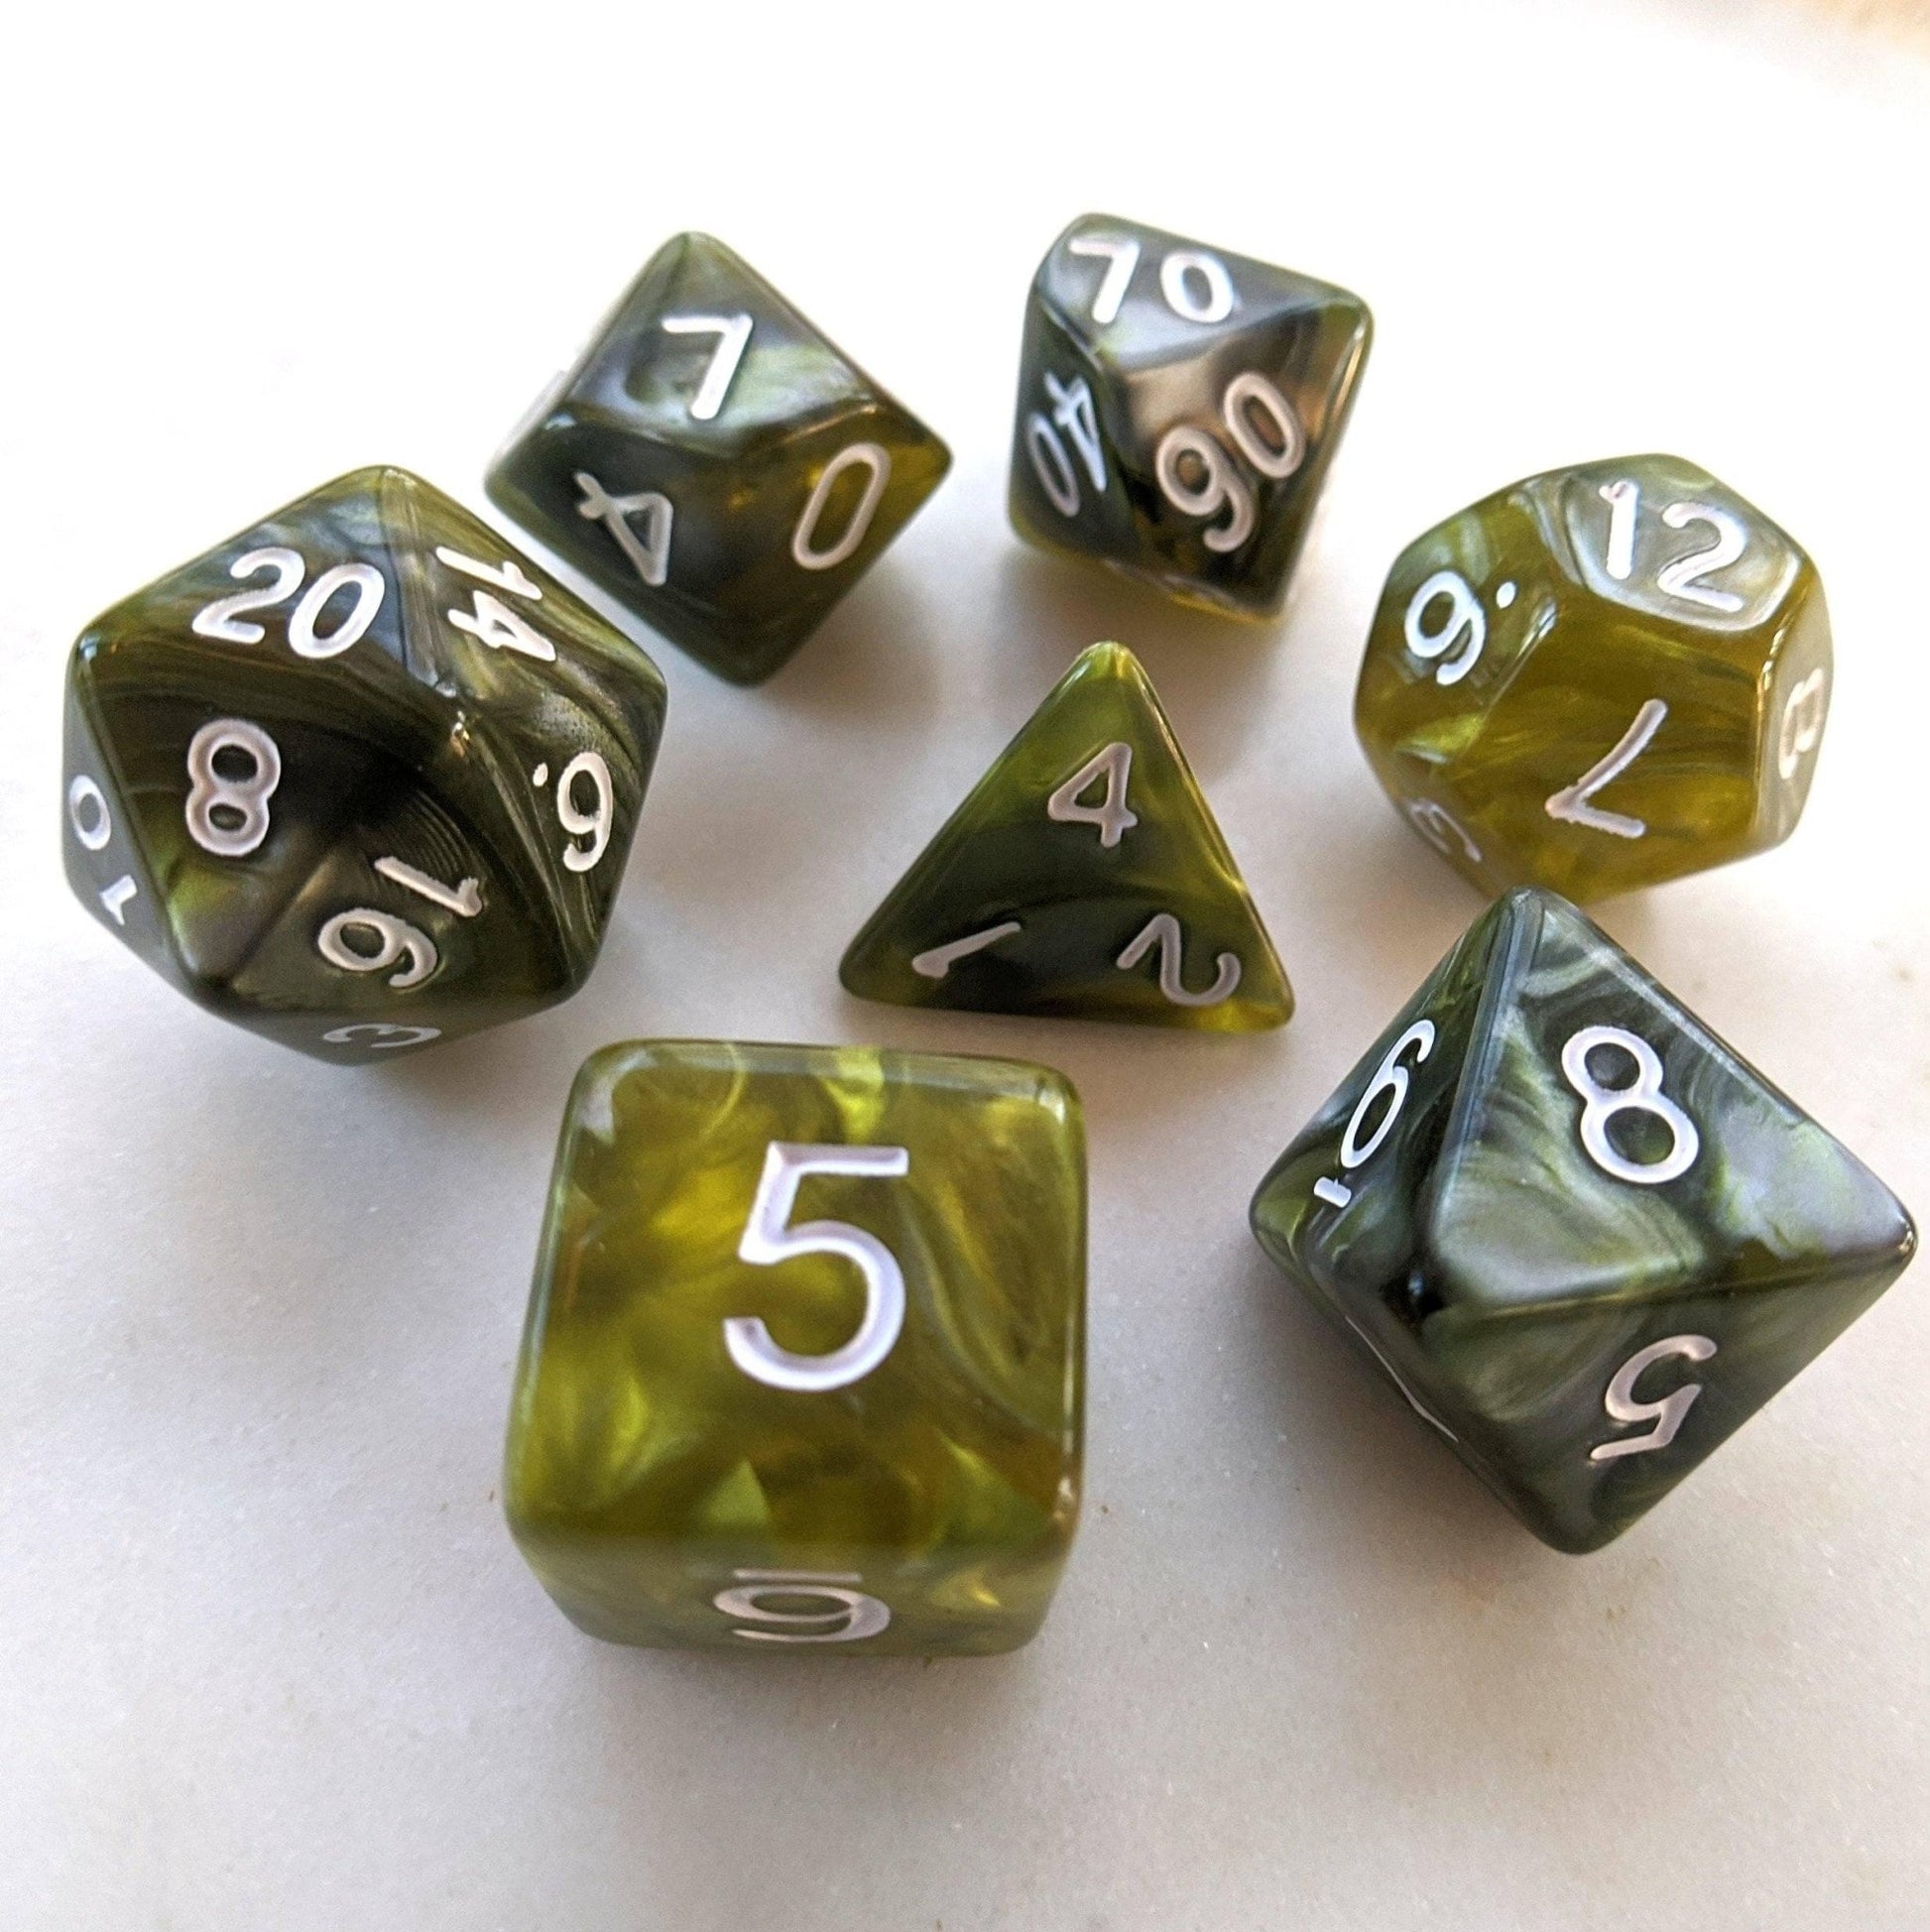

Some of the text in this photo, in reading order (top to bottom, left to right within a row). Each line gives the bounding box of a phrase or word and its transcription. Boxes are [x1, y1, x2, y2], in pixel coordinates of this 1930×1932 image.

[1069, 236, 1235, 323] 70
[662, 313, 754, 420] 7
[791, 443, 891, 570] 0
[1028, 373, 1106, 517] 40
[1156, 373, 1305, 552] 90
[573, 471, 673, 586] 4
[1599, 480, 1748, 612] 12
[192, 547, 385, 659] 20
[436, 546, 555, 662] 14
[185, 718, 282, 856] 8
[1048, 742, 1137, 848] 4
[1545, 698, 1668, 838] 7
[1117, 913, 1242, 1007] 2
[1561, 1026, 1700, 1183] 8
[724, 1141, 909, 1391] 5
[1590, 1334, 1717, 1461] 5
